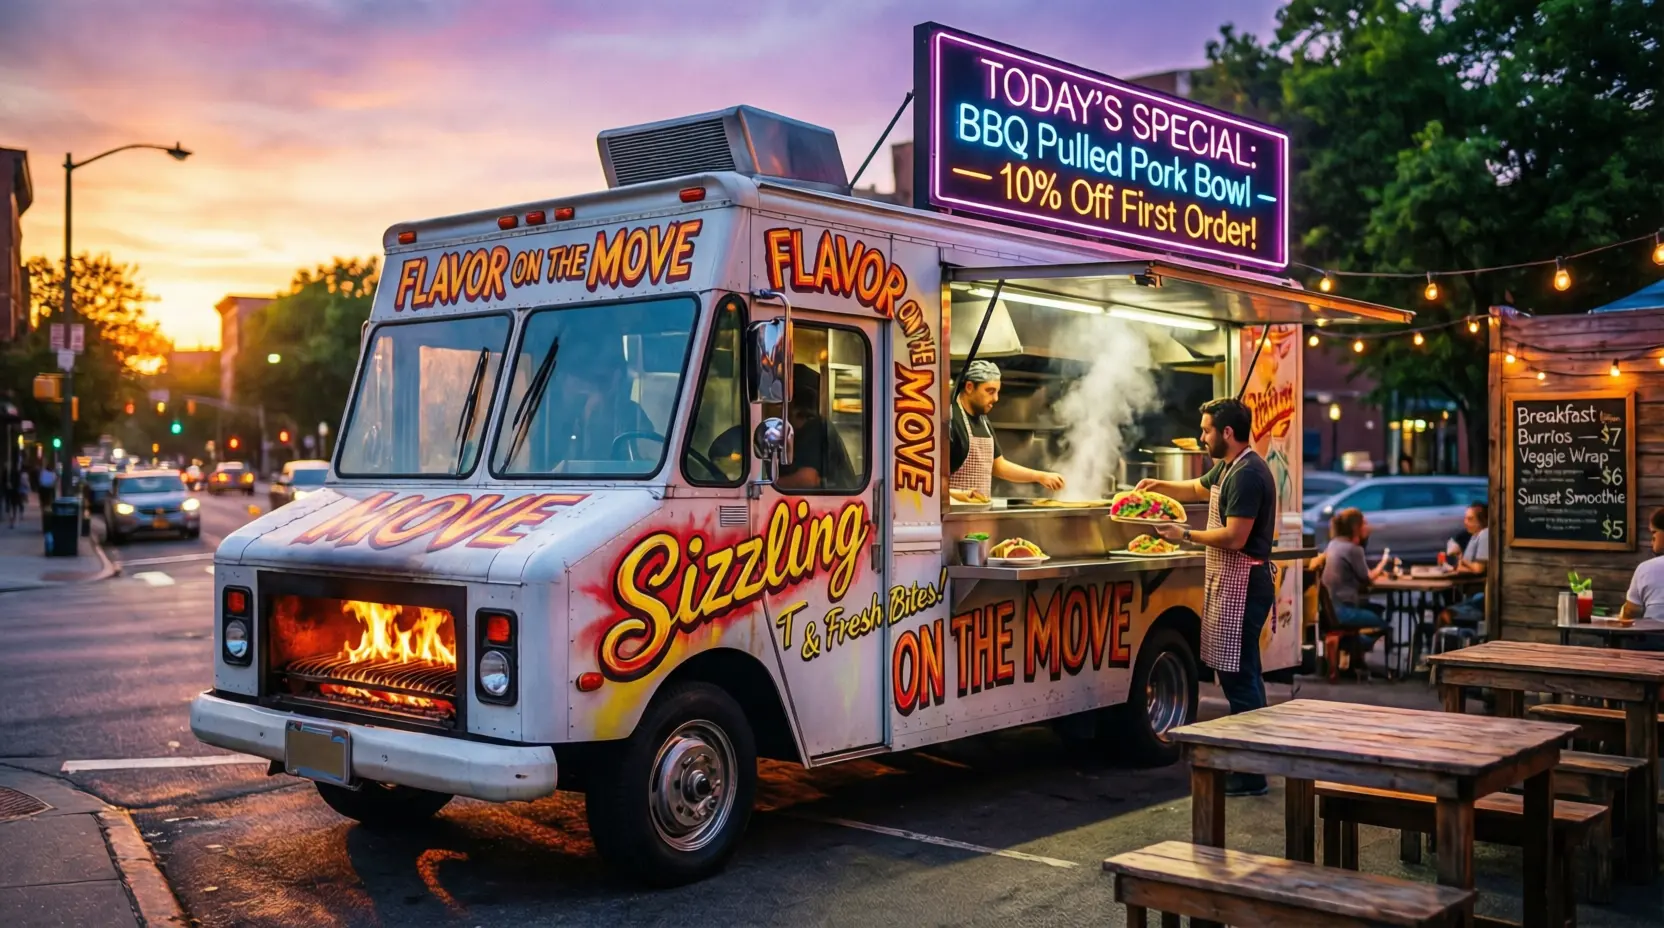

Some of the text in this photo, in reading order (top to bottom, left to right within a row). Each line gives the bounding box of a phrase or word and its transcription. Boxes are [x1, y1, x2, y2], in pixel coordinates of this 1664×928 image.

[959, 103, 1251, 208] BBQ Pulled Pork Bowl
[981, 58, 1257, 169] TODAY'S SPECIAL:
[1000, 162, 1257, 250] 10% Off First Order!
[394, 218, 703, 312] FLAVOR ON THE MOVE
[764, 227, 907, 319] FLAVOR
[894, 361, 935, 497] MOVE
[1517, 403, 1597, 426] Breakfast
[1519, 446, 1609, 469] Veggie Wrap
[1601, 423, 1622, 446] $7
[1517, 487, 1625, 505] Sunset Smoothie
[1601, 465, 1623, 486] $6
[289, 491, 592, 553] MOVE
[1601, 513, 1624, 540] $5
[600, 499, 870, 683] Sizzling
[776, 567, 948, 662] T & Fresh Bites!
[892, 580, 1134, 717] ON THE MOVE
